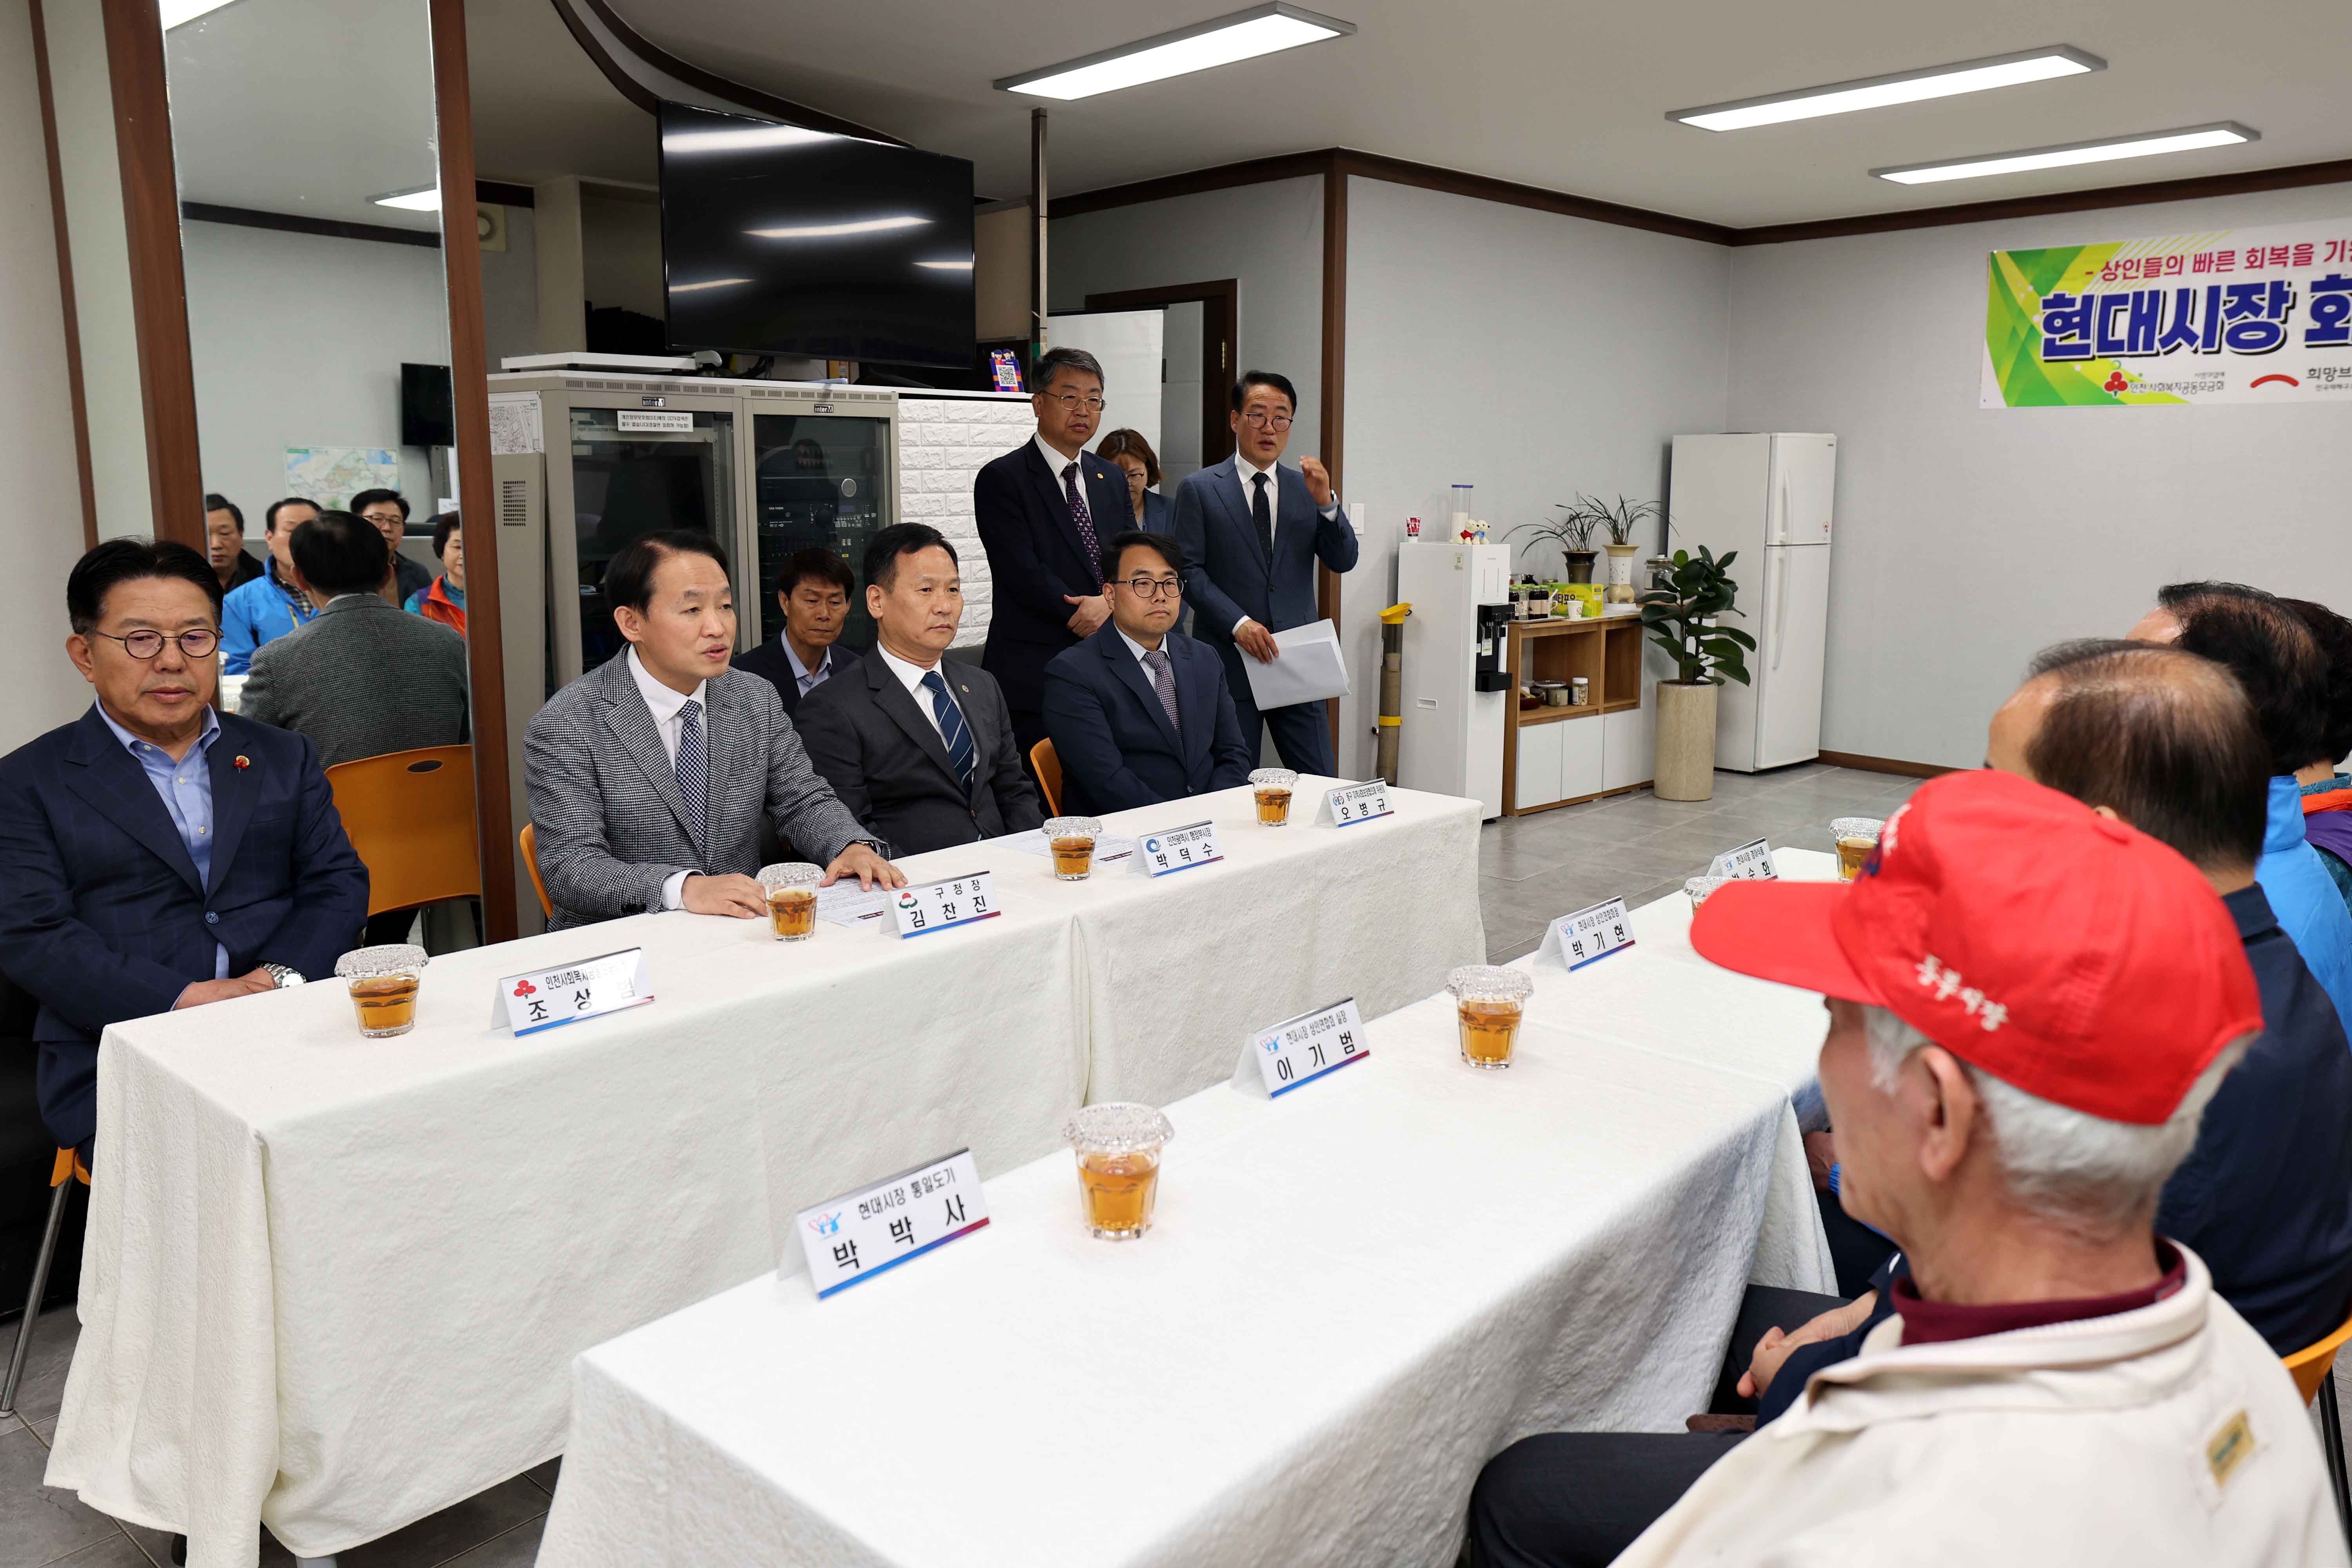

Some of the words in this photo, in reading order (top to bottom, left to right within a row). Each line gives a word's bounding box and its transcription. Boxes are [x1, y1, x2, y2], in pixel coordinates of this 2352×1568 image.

[2101, 255, 2184, 281] 상인들의
[2192, 250, 2236, 274] 빠른
[2245, 242, 2314, 270] 회복을
[2323, 240, 2352, 263] 기
[2042, 279, 2291, 359] 현대시장
[1167, 832, 1190, 846] 인천광역시
[1189, 827, 1212, 841] 행정부시장
[1578, 916, 1595, 931] 현대시장
[1595, 907, 1619, 925] 상인연합회장
[1286, 1026, 1309, 1045] 현대시장
[1309, 1015, 1336, 1036] 상인연합회
[858, 1188, 906, 1221] 현대시장
[910, 1166, 956, 1199] 통일도기
